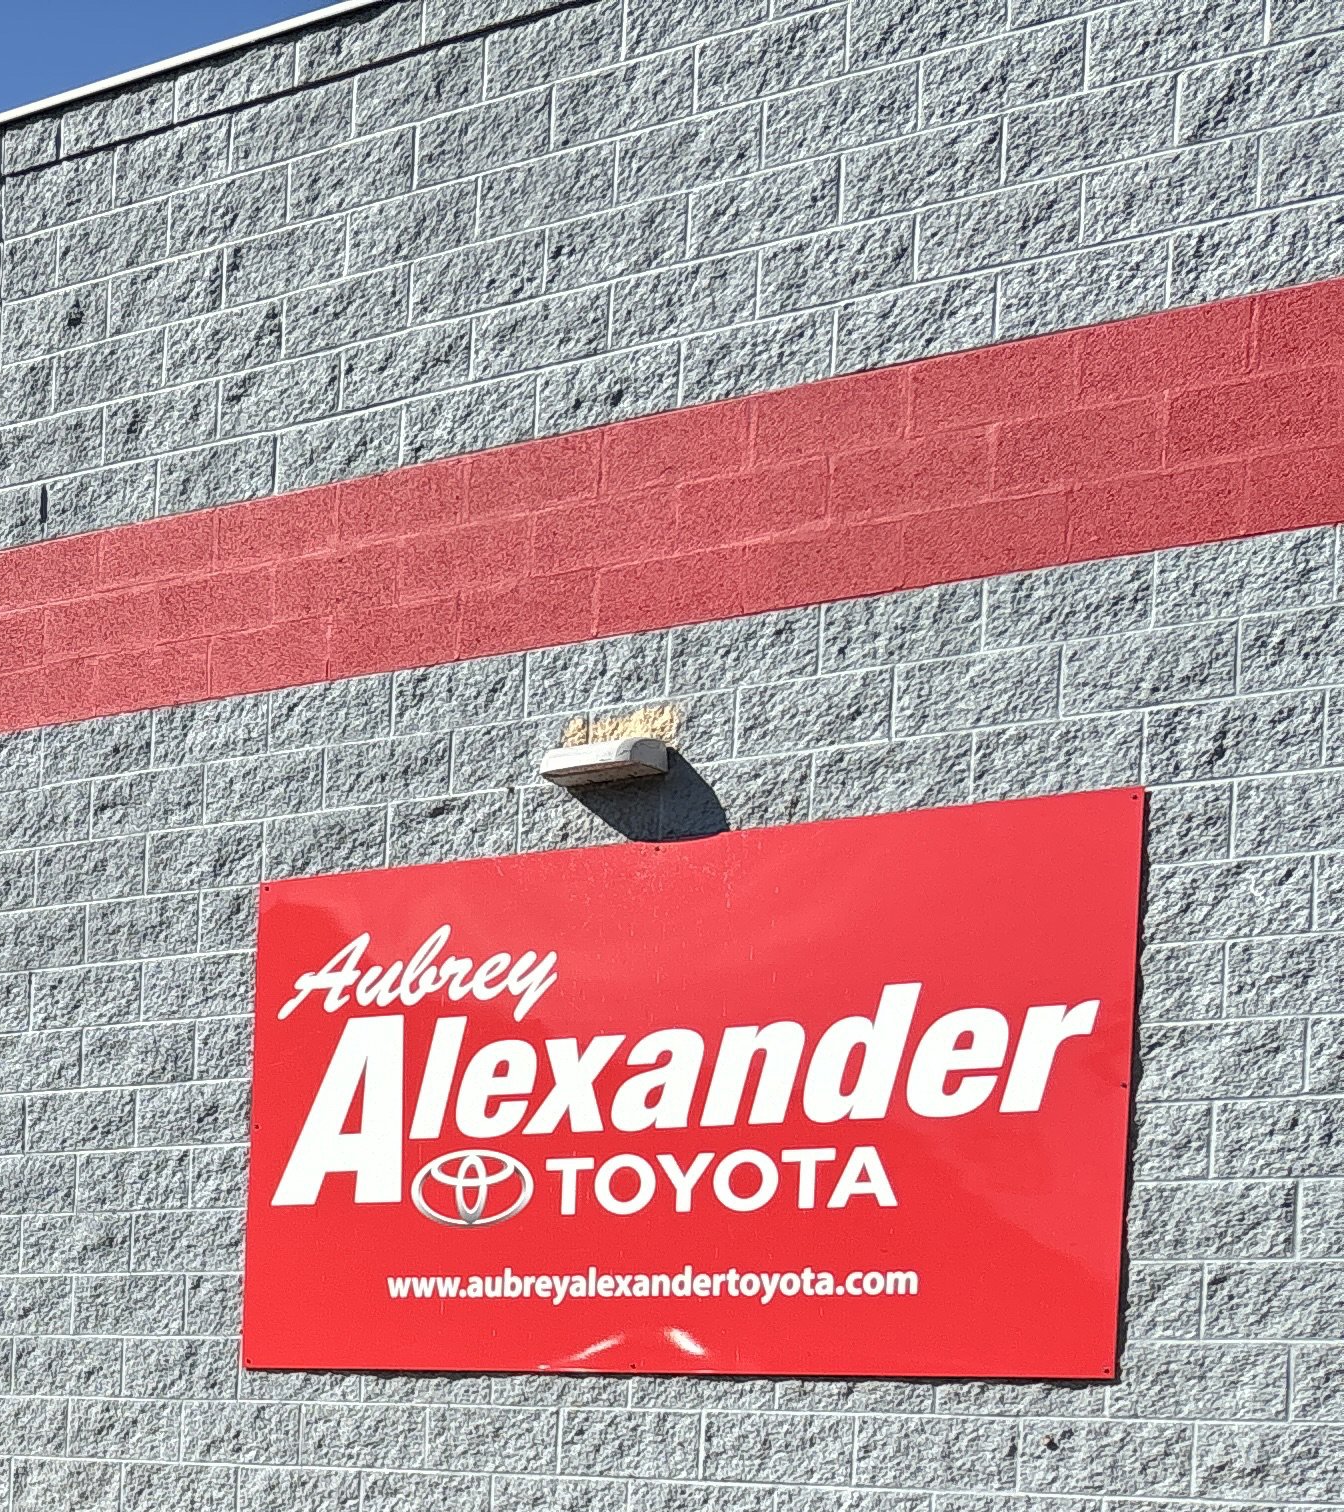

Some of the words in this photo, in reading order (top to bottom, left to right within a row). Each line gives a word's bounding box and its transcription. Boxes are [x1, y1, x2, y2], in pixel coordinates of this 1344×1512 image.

[277, 924, 558, 1023] Aubrey
[270, 982, 1102, 1207] Alexander
[544, 1145, 899, 1216] TOYOTA
[387, 1265, 920, 1306] www.aubreyalexandertoyota.com
